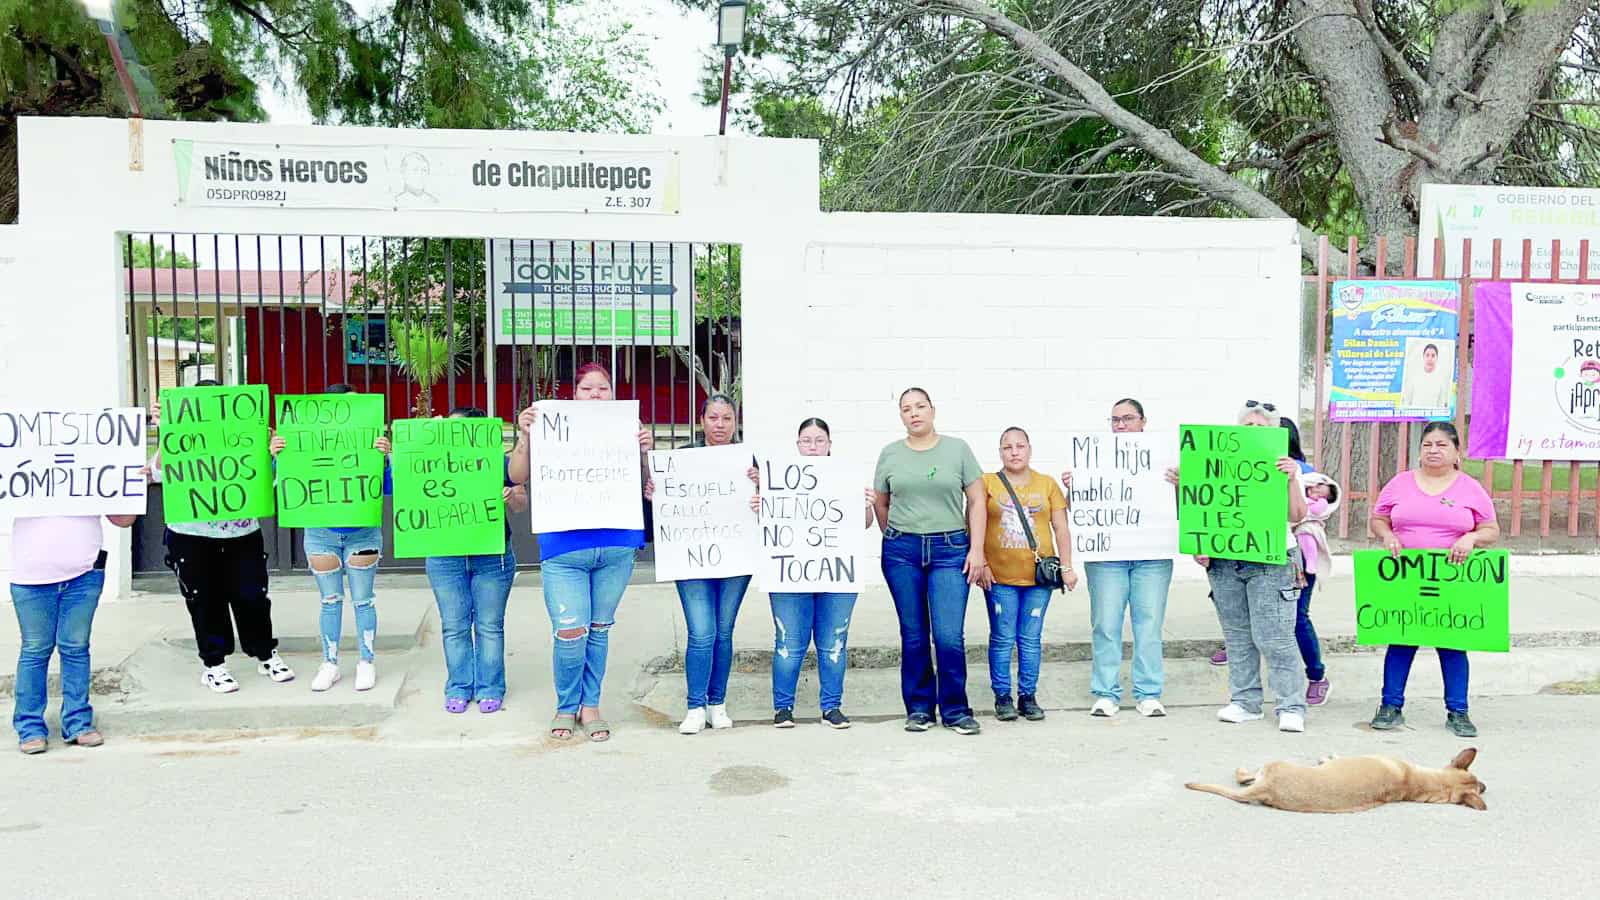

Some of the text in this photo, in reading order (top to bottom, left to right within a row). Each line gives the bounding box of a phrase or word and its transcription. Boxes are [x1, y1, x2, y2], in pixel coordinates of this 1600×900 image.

[204, 151, 368, 184] Niños Heroes
[472, 159, 651, 191] de Chapultepec
[206, 188, 286, 201] 05DPR0982J
[605, 196, 652, 208] Z.E. 307
[1497, 193, 1595, 206] GOBIERNO DEL
[517, 264, 663, 281] CONSTRUYE
[279, 399, 351, 426] ACOSO
[542, 411, 570, 443] Mi
[1180, 429, 1197, 452] A
[653, 455, 677, 473] LA
[1072, 435, 1152, 476] Mi hija
[1204, 455, 1270, 483] NIÑOS
[422, 479, 457, 498] es
[766, 460, 818, 491] LOS
[189, 483, 247, 519] NO
[280, 474, 382, 510] DELITO
[1120, 478, 1133, 502] la
[1183, 483, 1249, 508] NO SE
[394, 498, 499, 532] CULPABLE
[760, 493, 844, 523] NIÑOS
[1072, 505, 1141, 529] escuela
[763, 524, 839, 549] NO SE
[687, 543, 723, 568] NO
[771, 554, 855, 583] TOCAN
[1377, 550, 1505, 584] OMISIÓN
[1356, 602, 1486, 637] Complicidad
